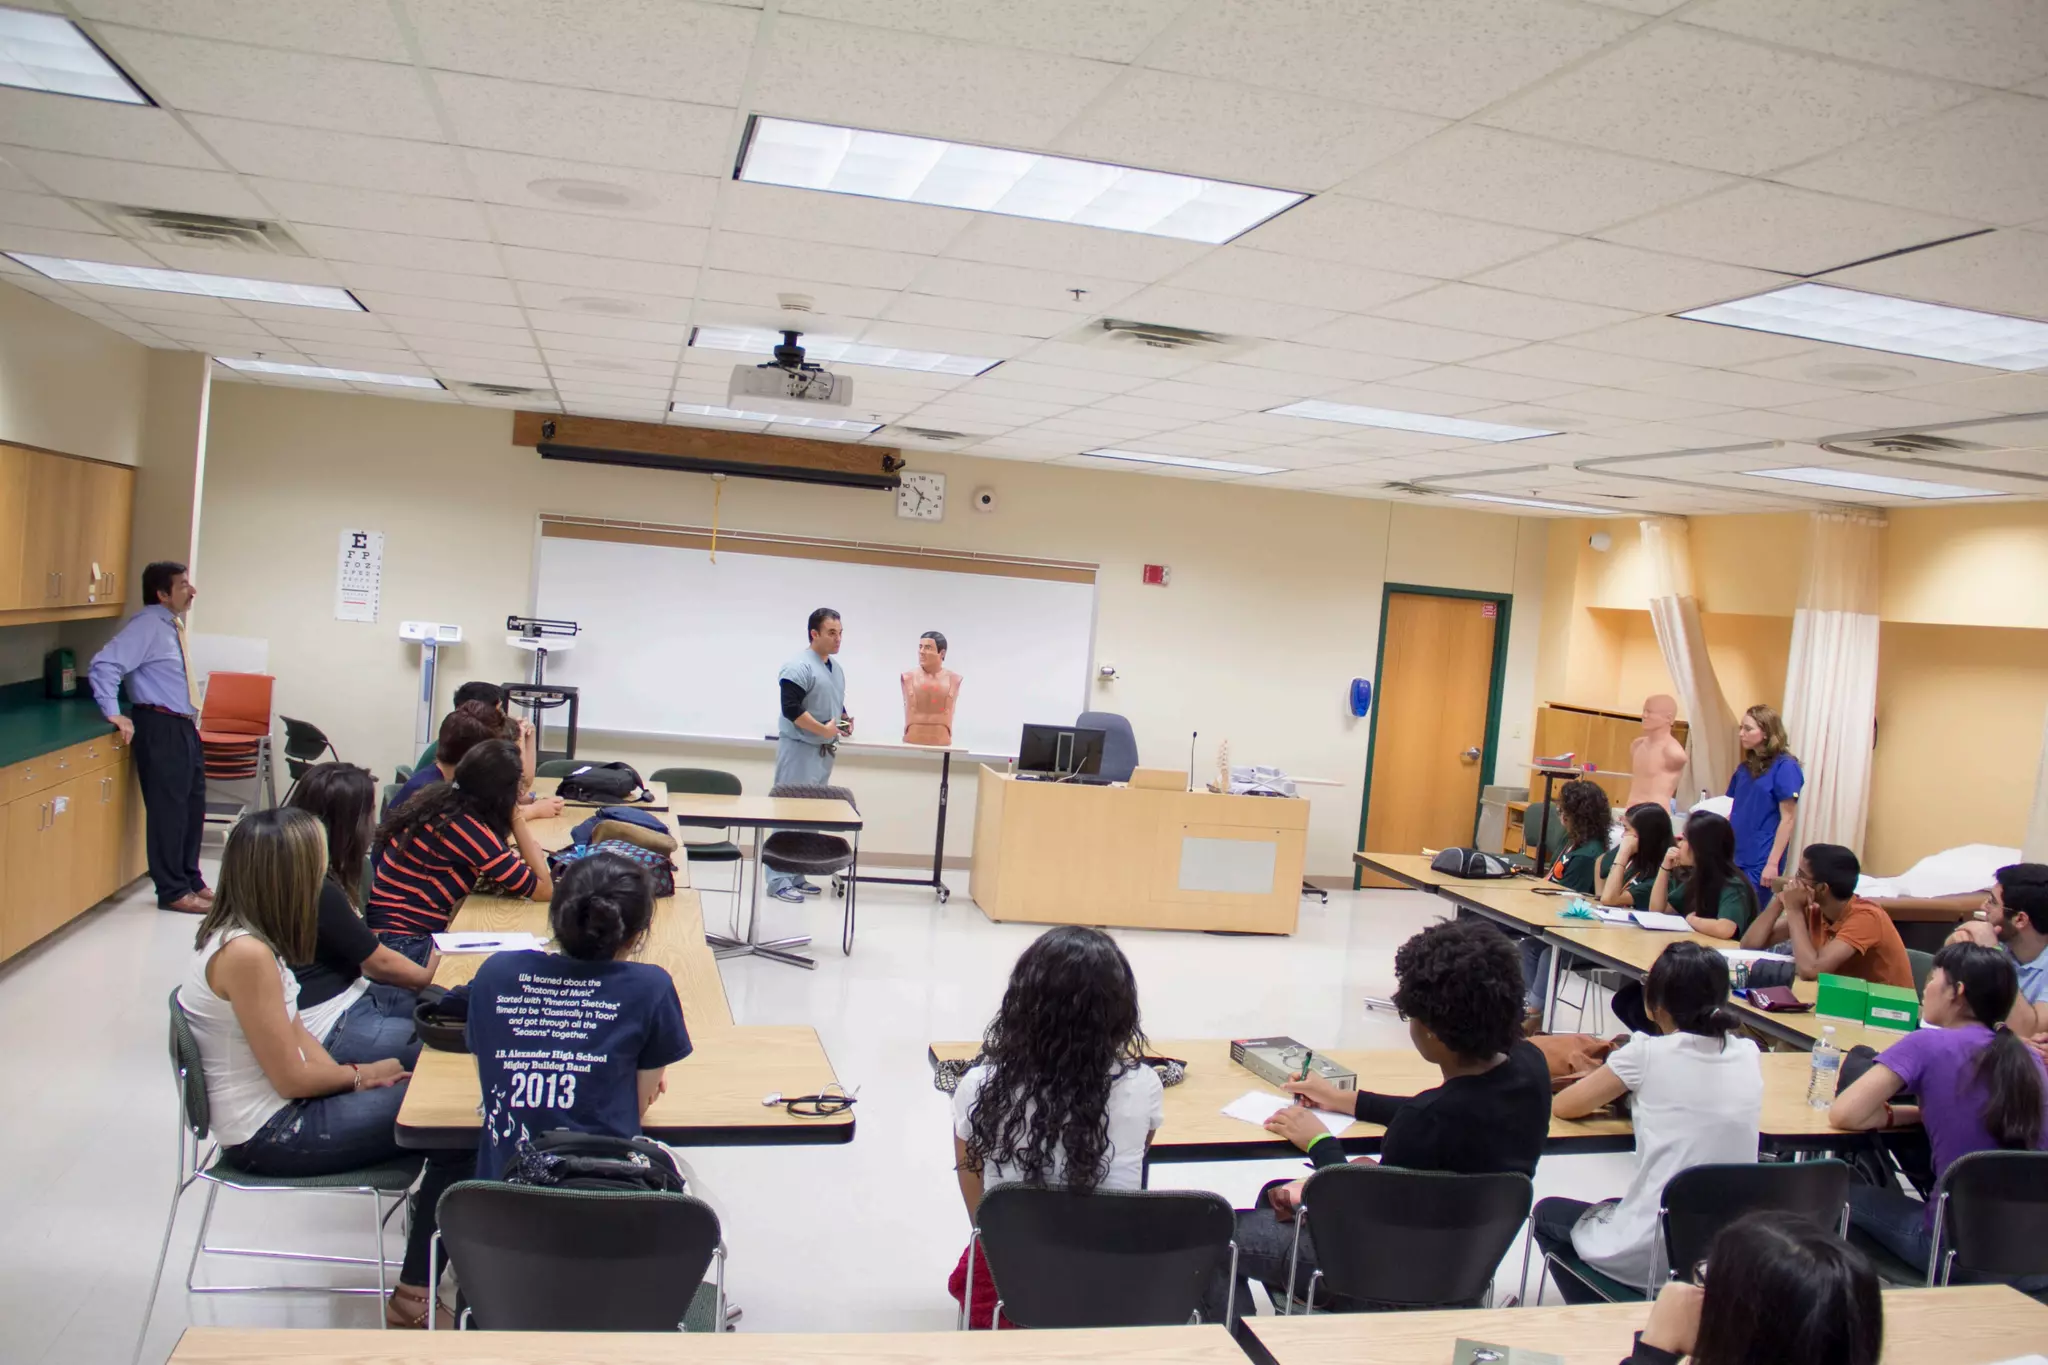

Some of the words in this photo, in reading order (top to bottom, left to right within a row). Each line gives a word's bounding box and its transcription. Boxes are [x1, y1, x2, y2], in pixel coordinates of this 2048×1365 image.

[352, 533, 367, 548] E
[348, 550, 356, 559] F
[518, 973, 532, 982] We
[533, 974, 562, 986] learned
[563, 978, 586, 987] about
[522, 984, 559, 997] "Anatomy
[560, 989, 570, 997] of
[569, 988, 595, 998] Music"
[496, 994, 523, 1004] Started
[524, 996, 541, 1005] with
[543, 997, 580, 1007] "American
[580, 999, 620, 1011] Sketches"
[528, 1006, 540, 1014] be
[541, 1007, 584, 1019] "Classically
[585, 1010, 592, 1018] in
[594, 1010, 618, 1021] Toon"
[508, 1017, 523, 1025] and
[524, 1018, 538, 1028] got
[539, 1018, 570, 1029] through
[571, 1020, 581, 1028] all
[583, 1021, 597, 1030] the
[512, 1028, 550, 1037] "Seasons"
[552, 1029, 588, 1040] together.
[508, 1049, 550, 1058] Alexander
[552, 1050, 574, 1060] High
[576, 1052, 608, 1062] School
[503, 1060, 530, 1071] Mighty
[532, 1061, 566, 1072] Bulldog
[566, 1062, 592, 1073] Band
[510, 1072, 576, 1110] 2013
